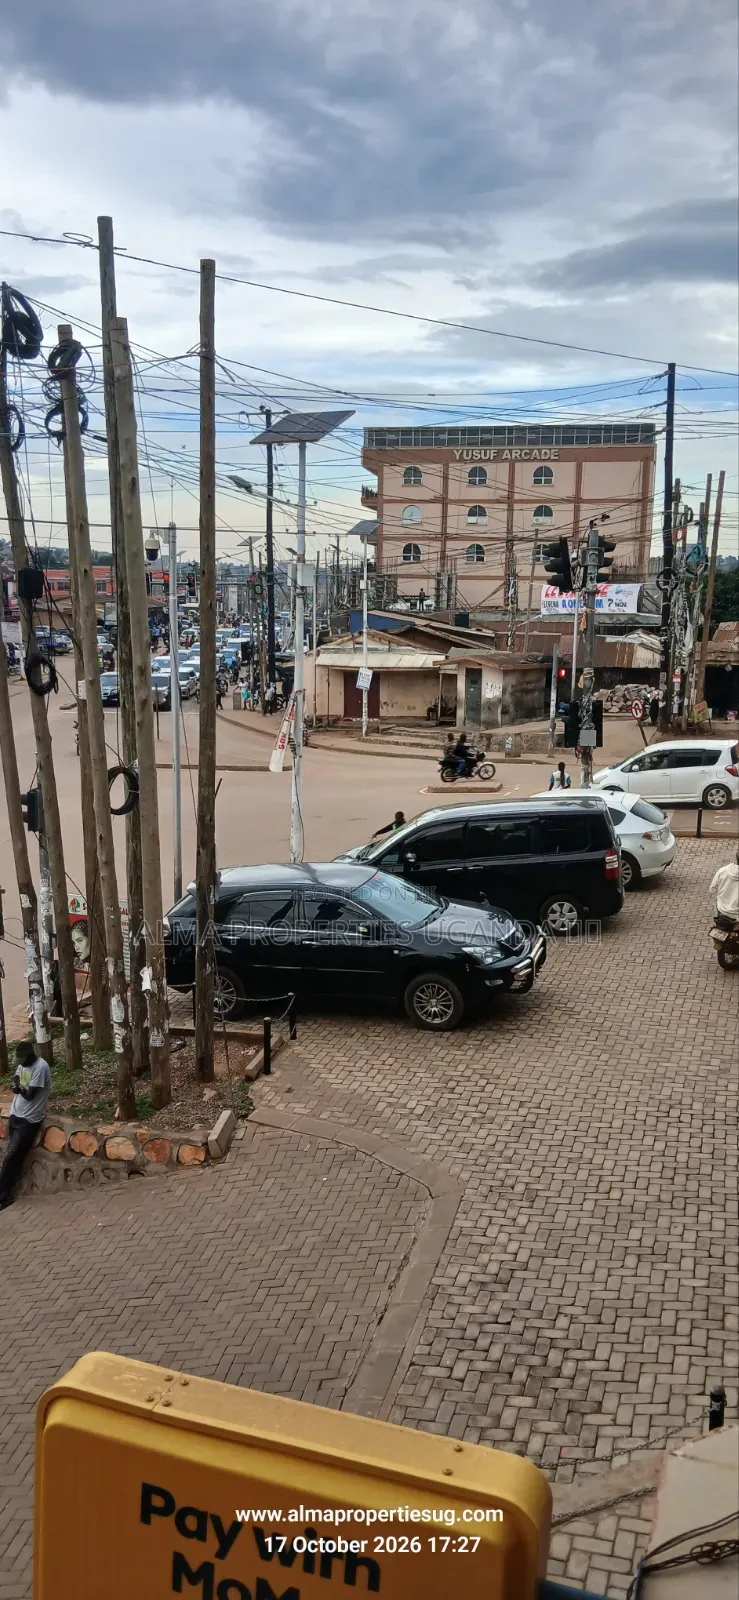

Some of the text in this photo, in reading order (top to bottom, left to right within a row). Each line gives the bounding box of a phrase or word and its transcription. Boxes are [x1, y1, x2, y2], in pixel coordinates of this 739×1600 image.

[453, 449, 559, 460] YUSUF ARCADE
[140, 1482, 381, 1592] Pay with
